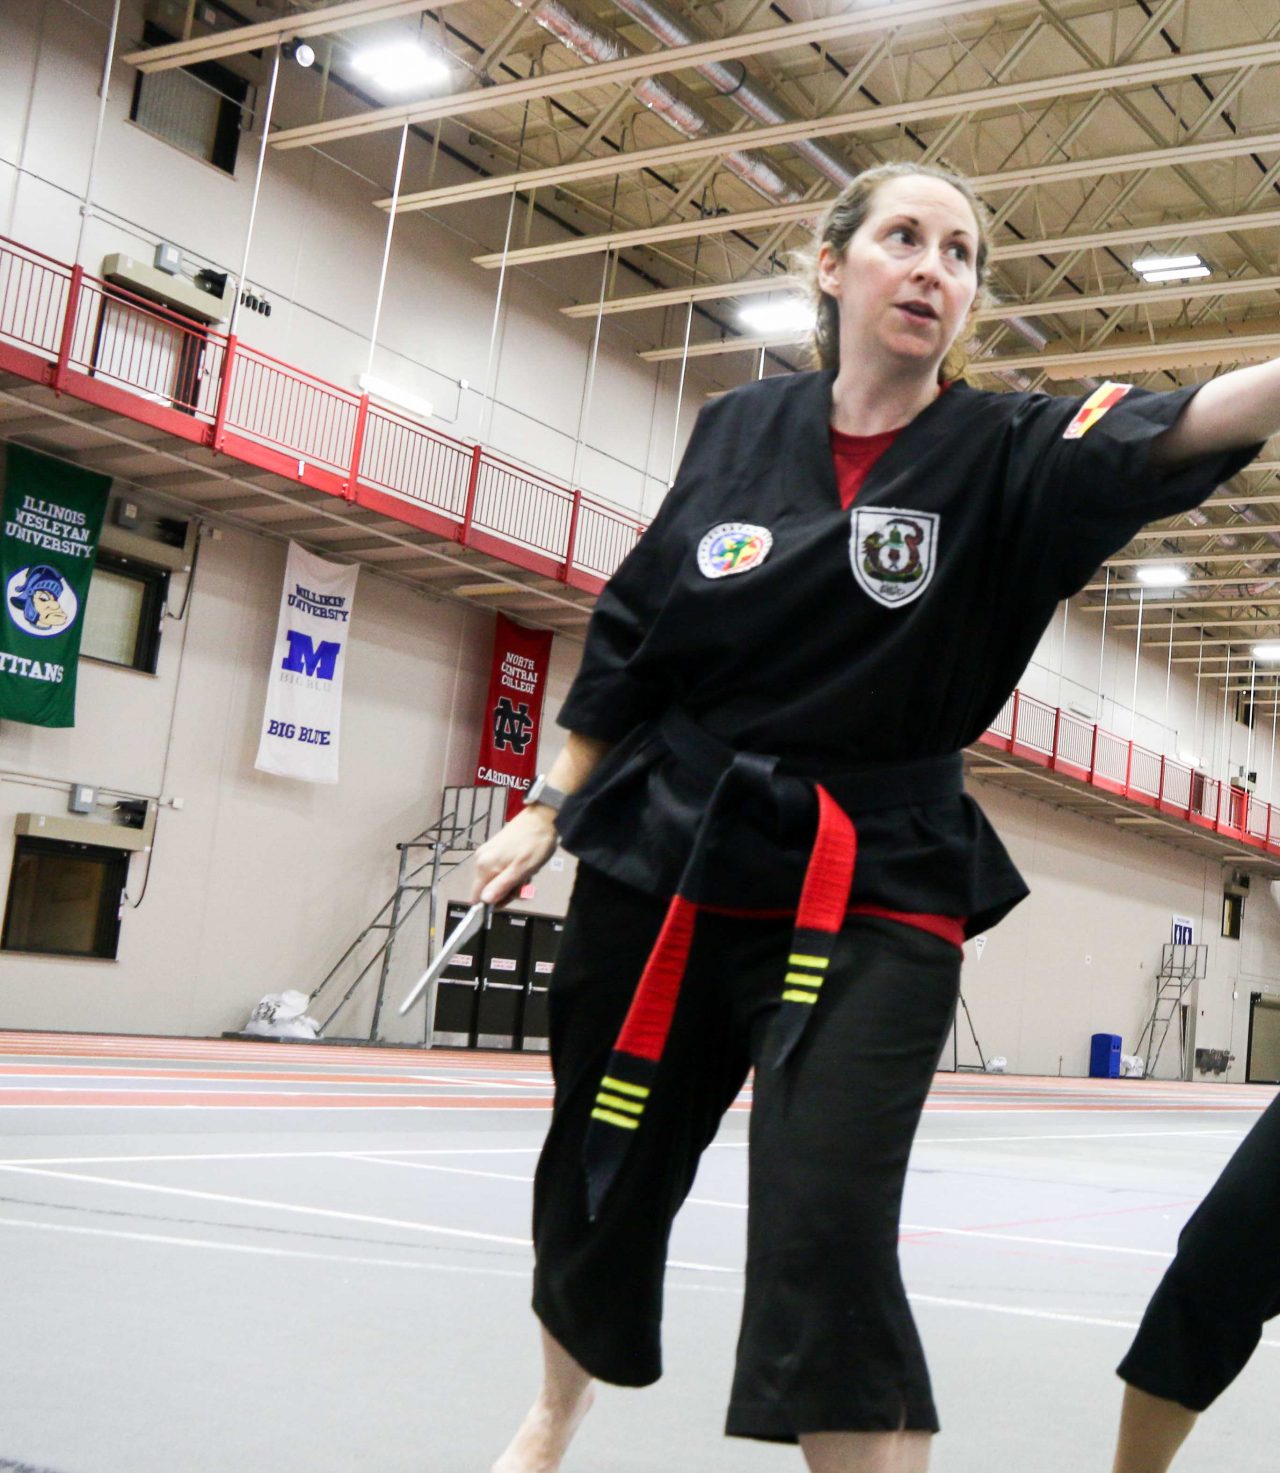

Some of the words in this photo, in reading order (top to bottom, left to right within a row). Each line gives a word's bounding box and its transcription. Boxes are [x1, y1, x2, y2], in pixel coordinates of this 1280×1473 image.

[15, 507, 91, 543] WESLEYAN
[23, 494, 87, 526] ILLINOIS
[5, 521, 94, 558] UNIVERSITY
[0, 651, 65, 684] TITANS
[281, 629, 341, 682] M
[506, 651, 536, 671] NORTH
[267, 719, 296, 739] BIG
[298, 726, 331, 746] BLUE
[477, 765, 531, 791] CARDINALS
